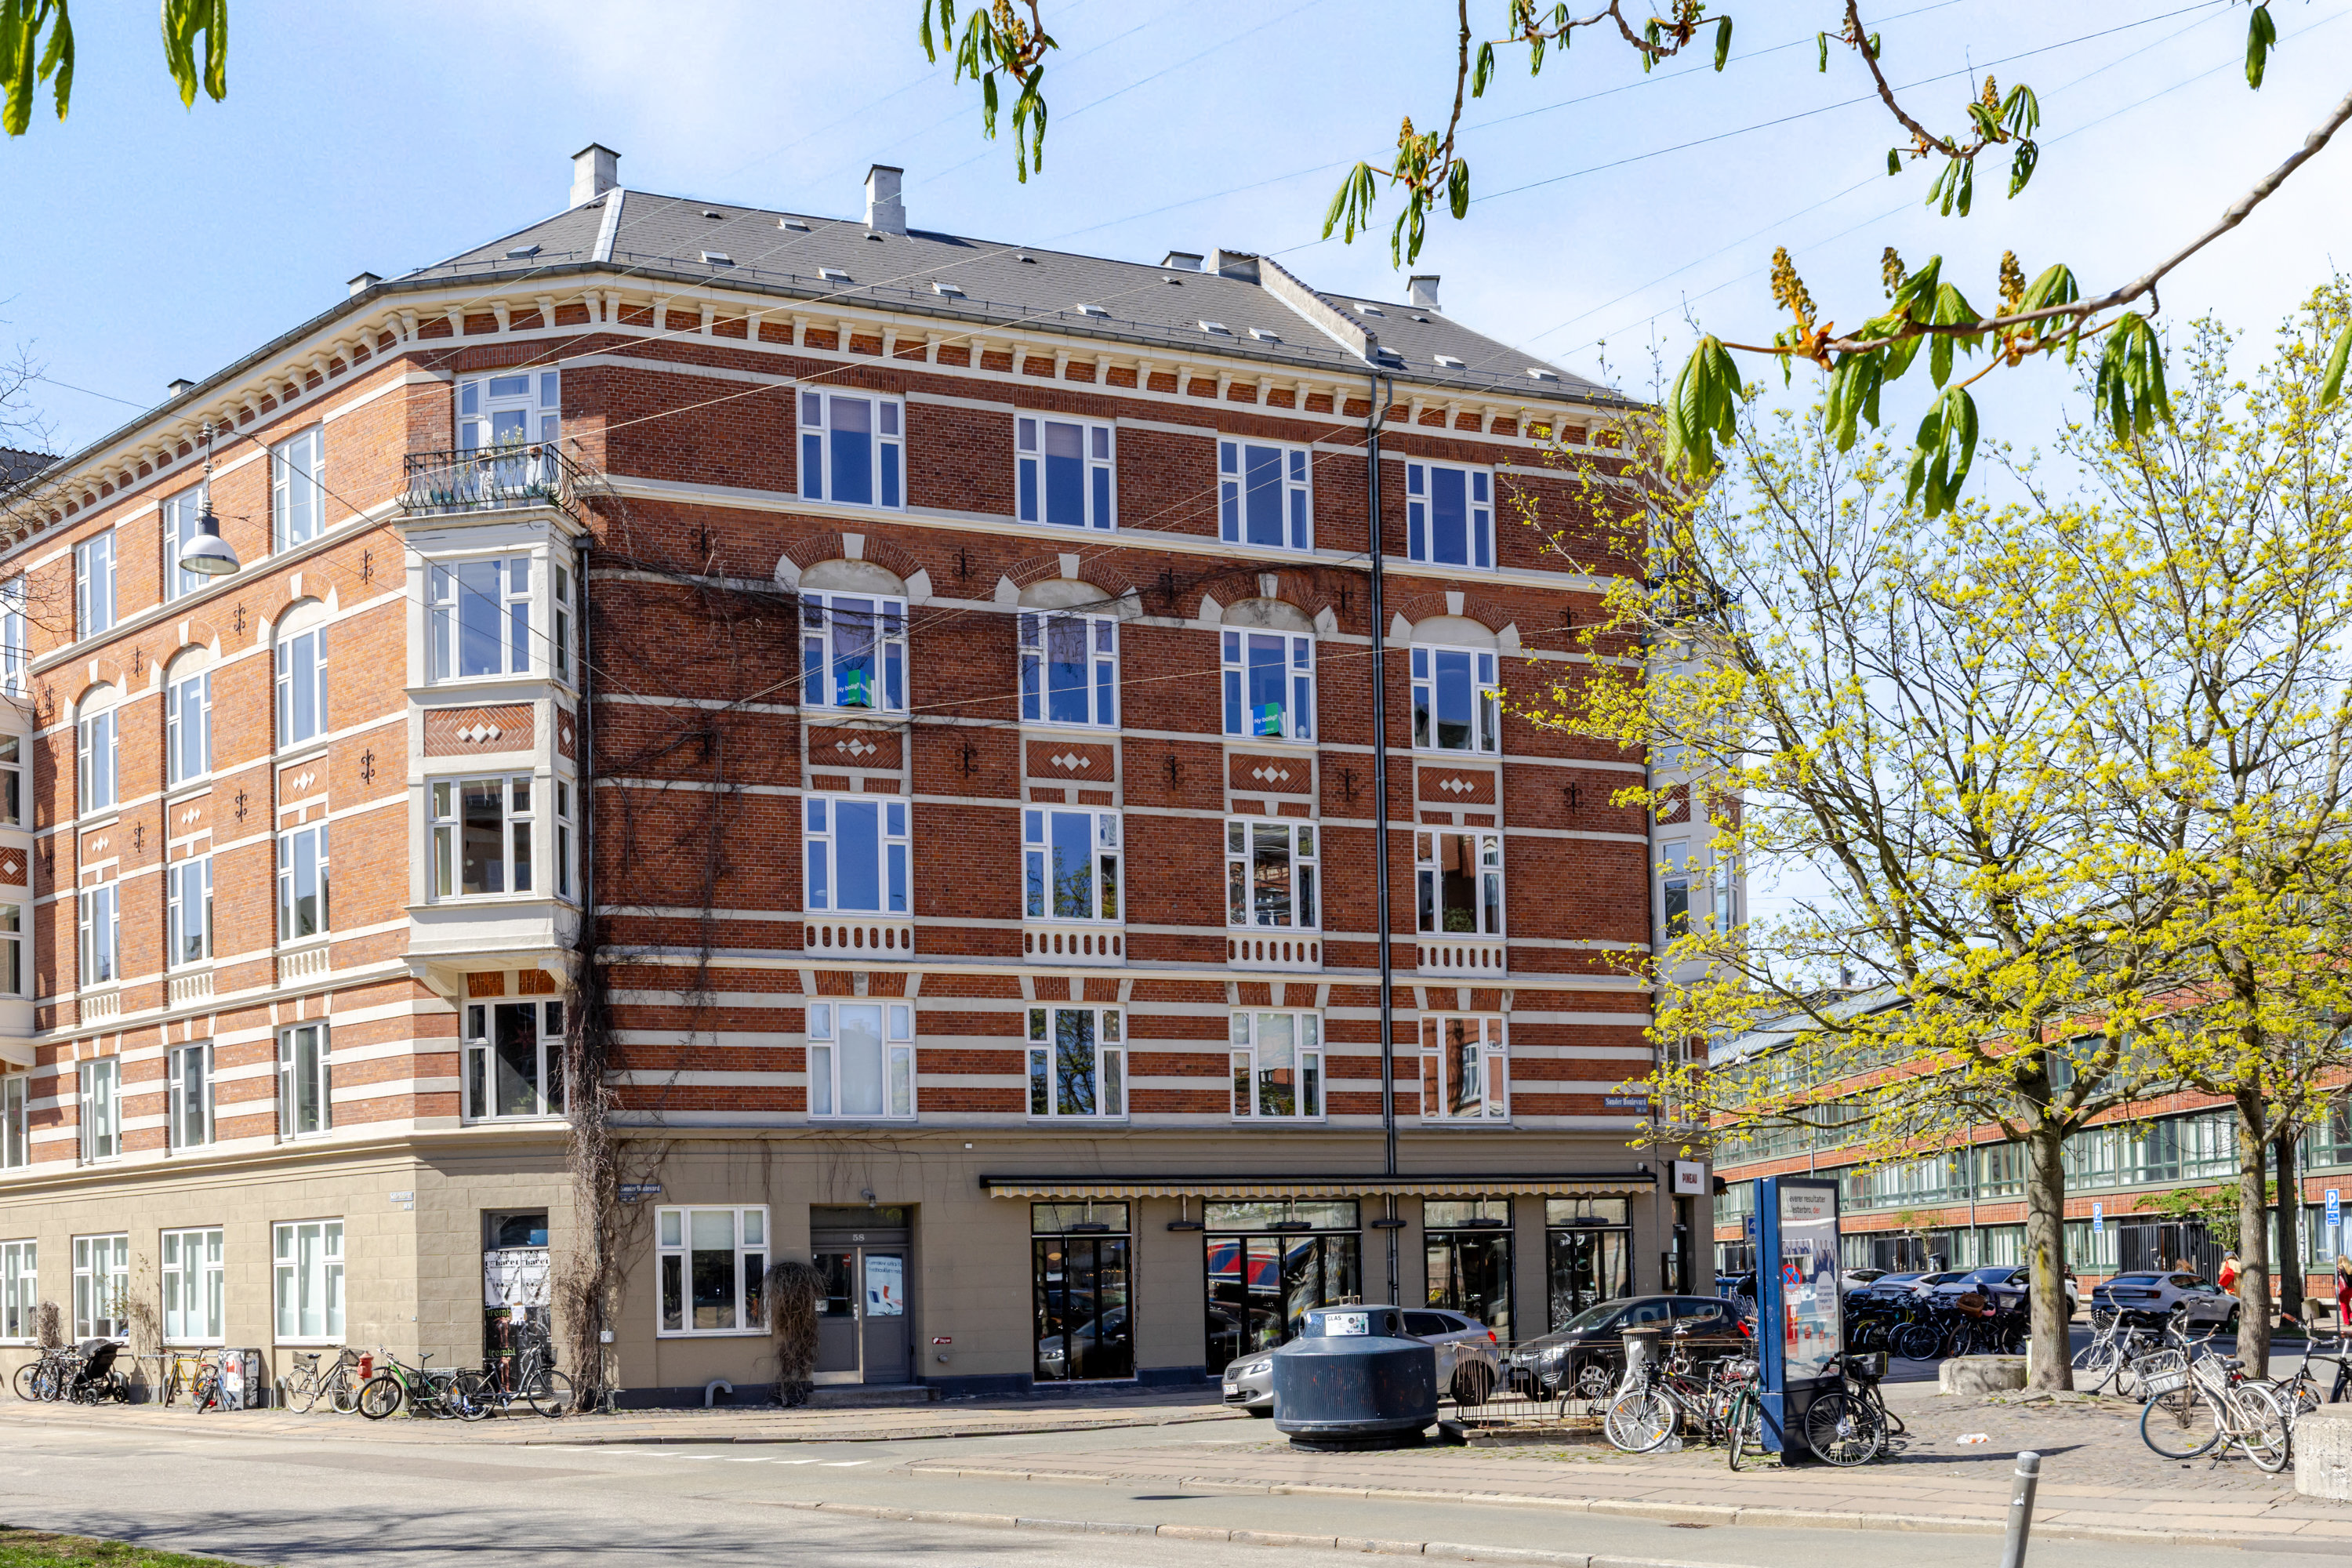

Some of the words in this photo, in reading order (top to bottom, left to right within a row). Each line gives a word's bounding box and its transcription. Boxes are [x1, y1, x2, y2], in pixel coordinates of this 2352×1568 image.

[1682, 1173, 1697, 1184] PINEAU
[2328, 1192, 2336, 1209] P
[2094, 1205, 2100, 1220] P
